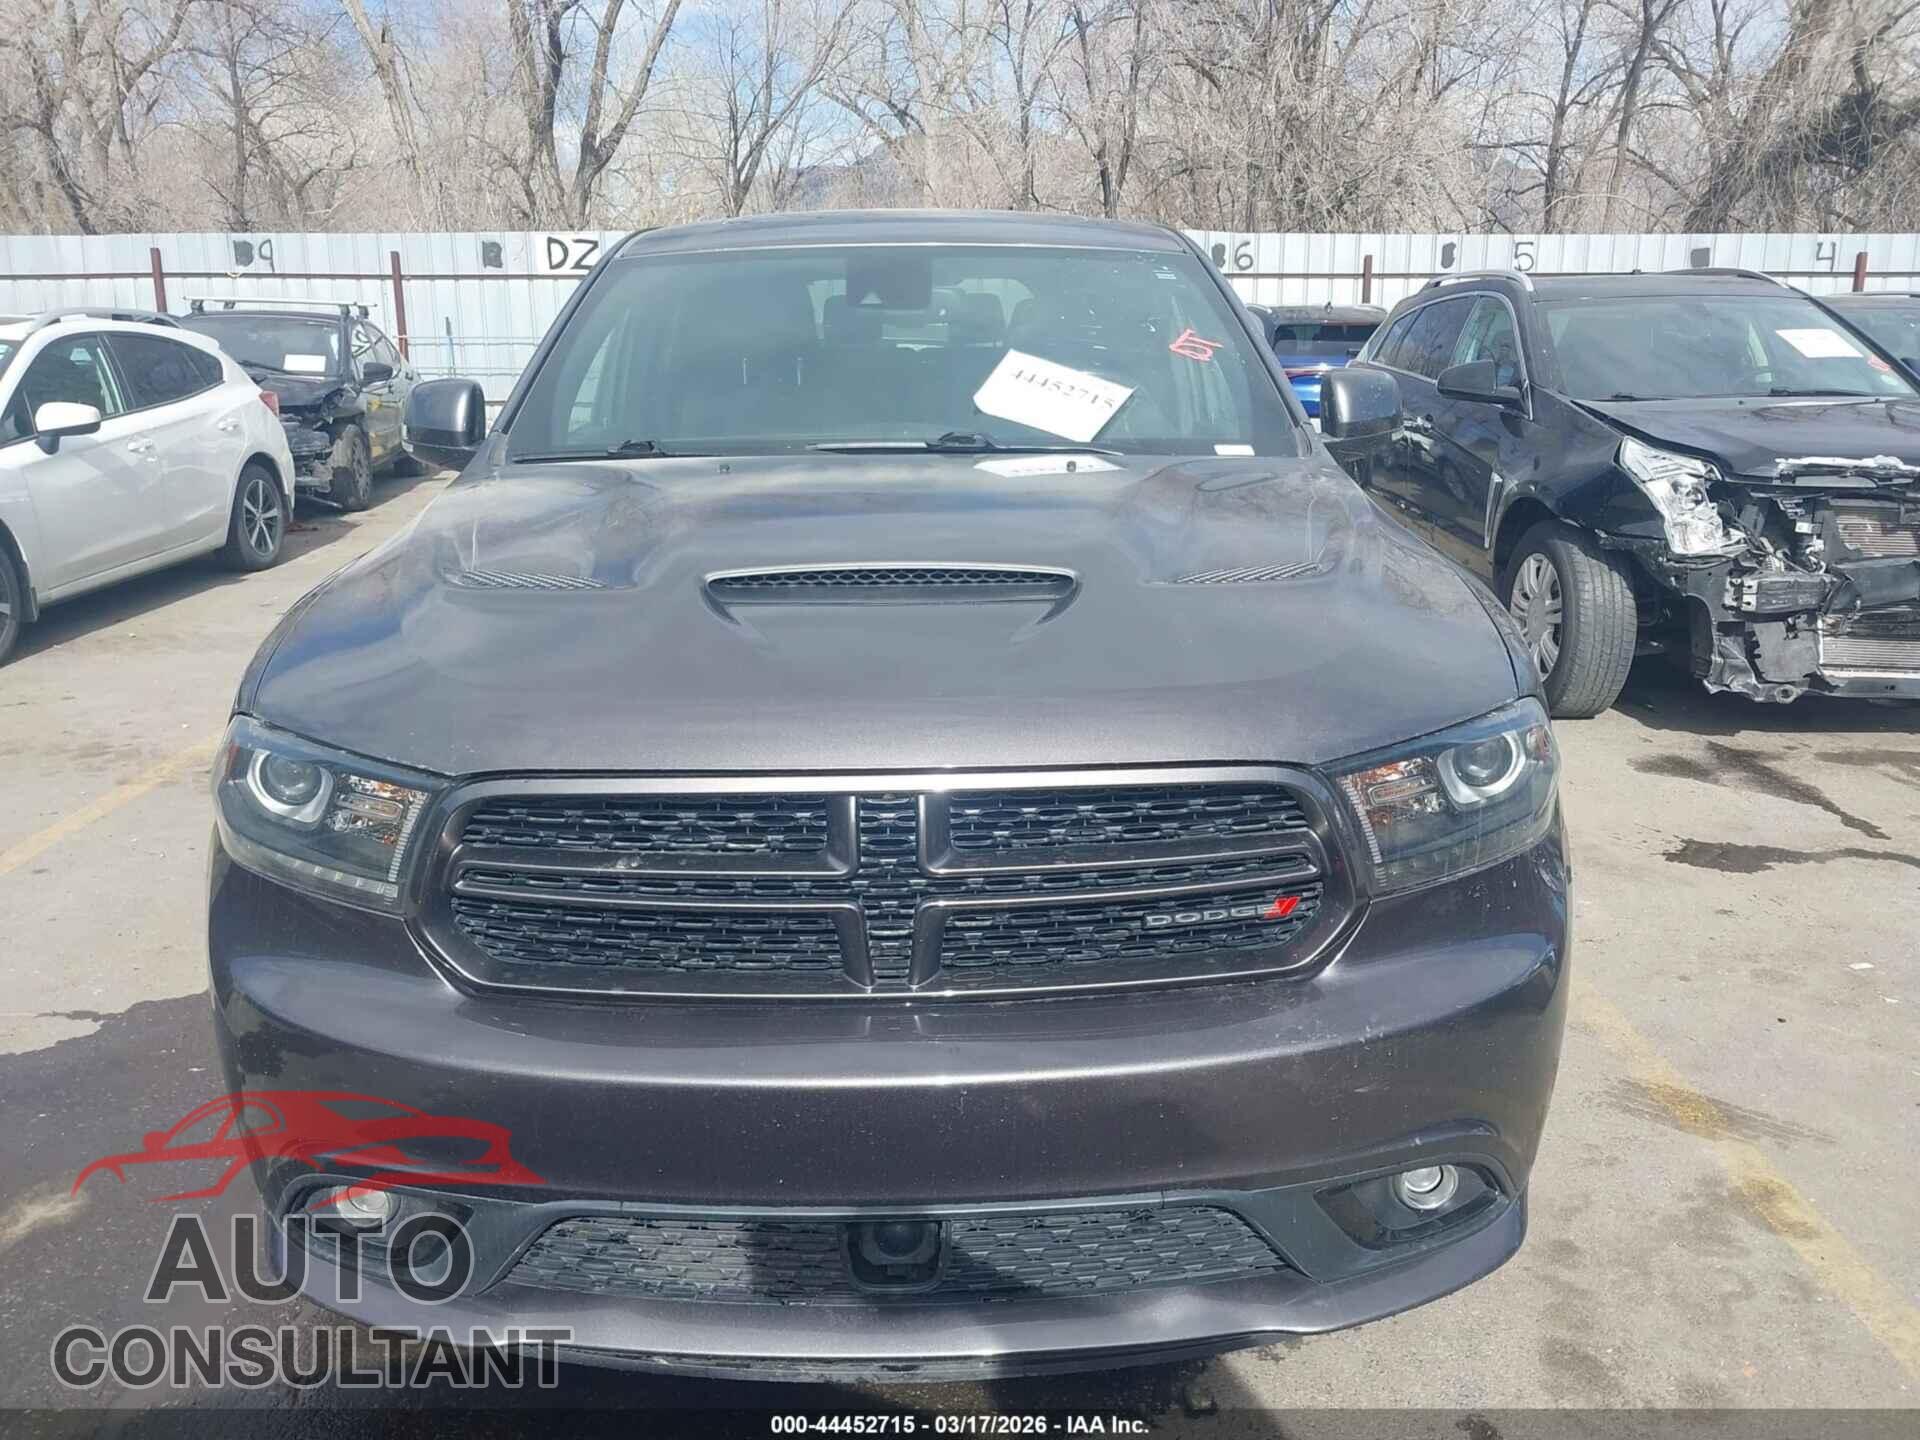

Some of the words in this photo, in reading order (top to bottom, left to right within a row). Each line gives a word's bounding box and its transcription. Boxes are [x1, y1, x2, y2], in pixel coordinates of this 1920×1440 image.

[1234, 241, 1254, 271] 6
[1514, 241, 1534, 271] 5
[1815, 242, 1836, 272] 4
[1010, 368, 1116, 409] 44452715
[1145, 905, 1276, 927] DODGE
